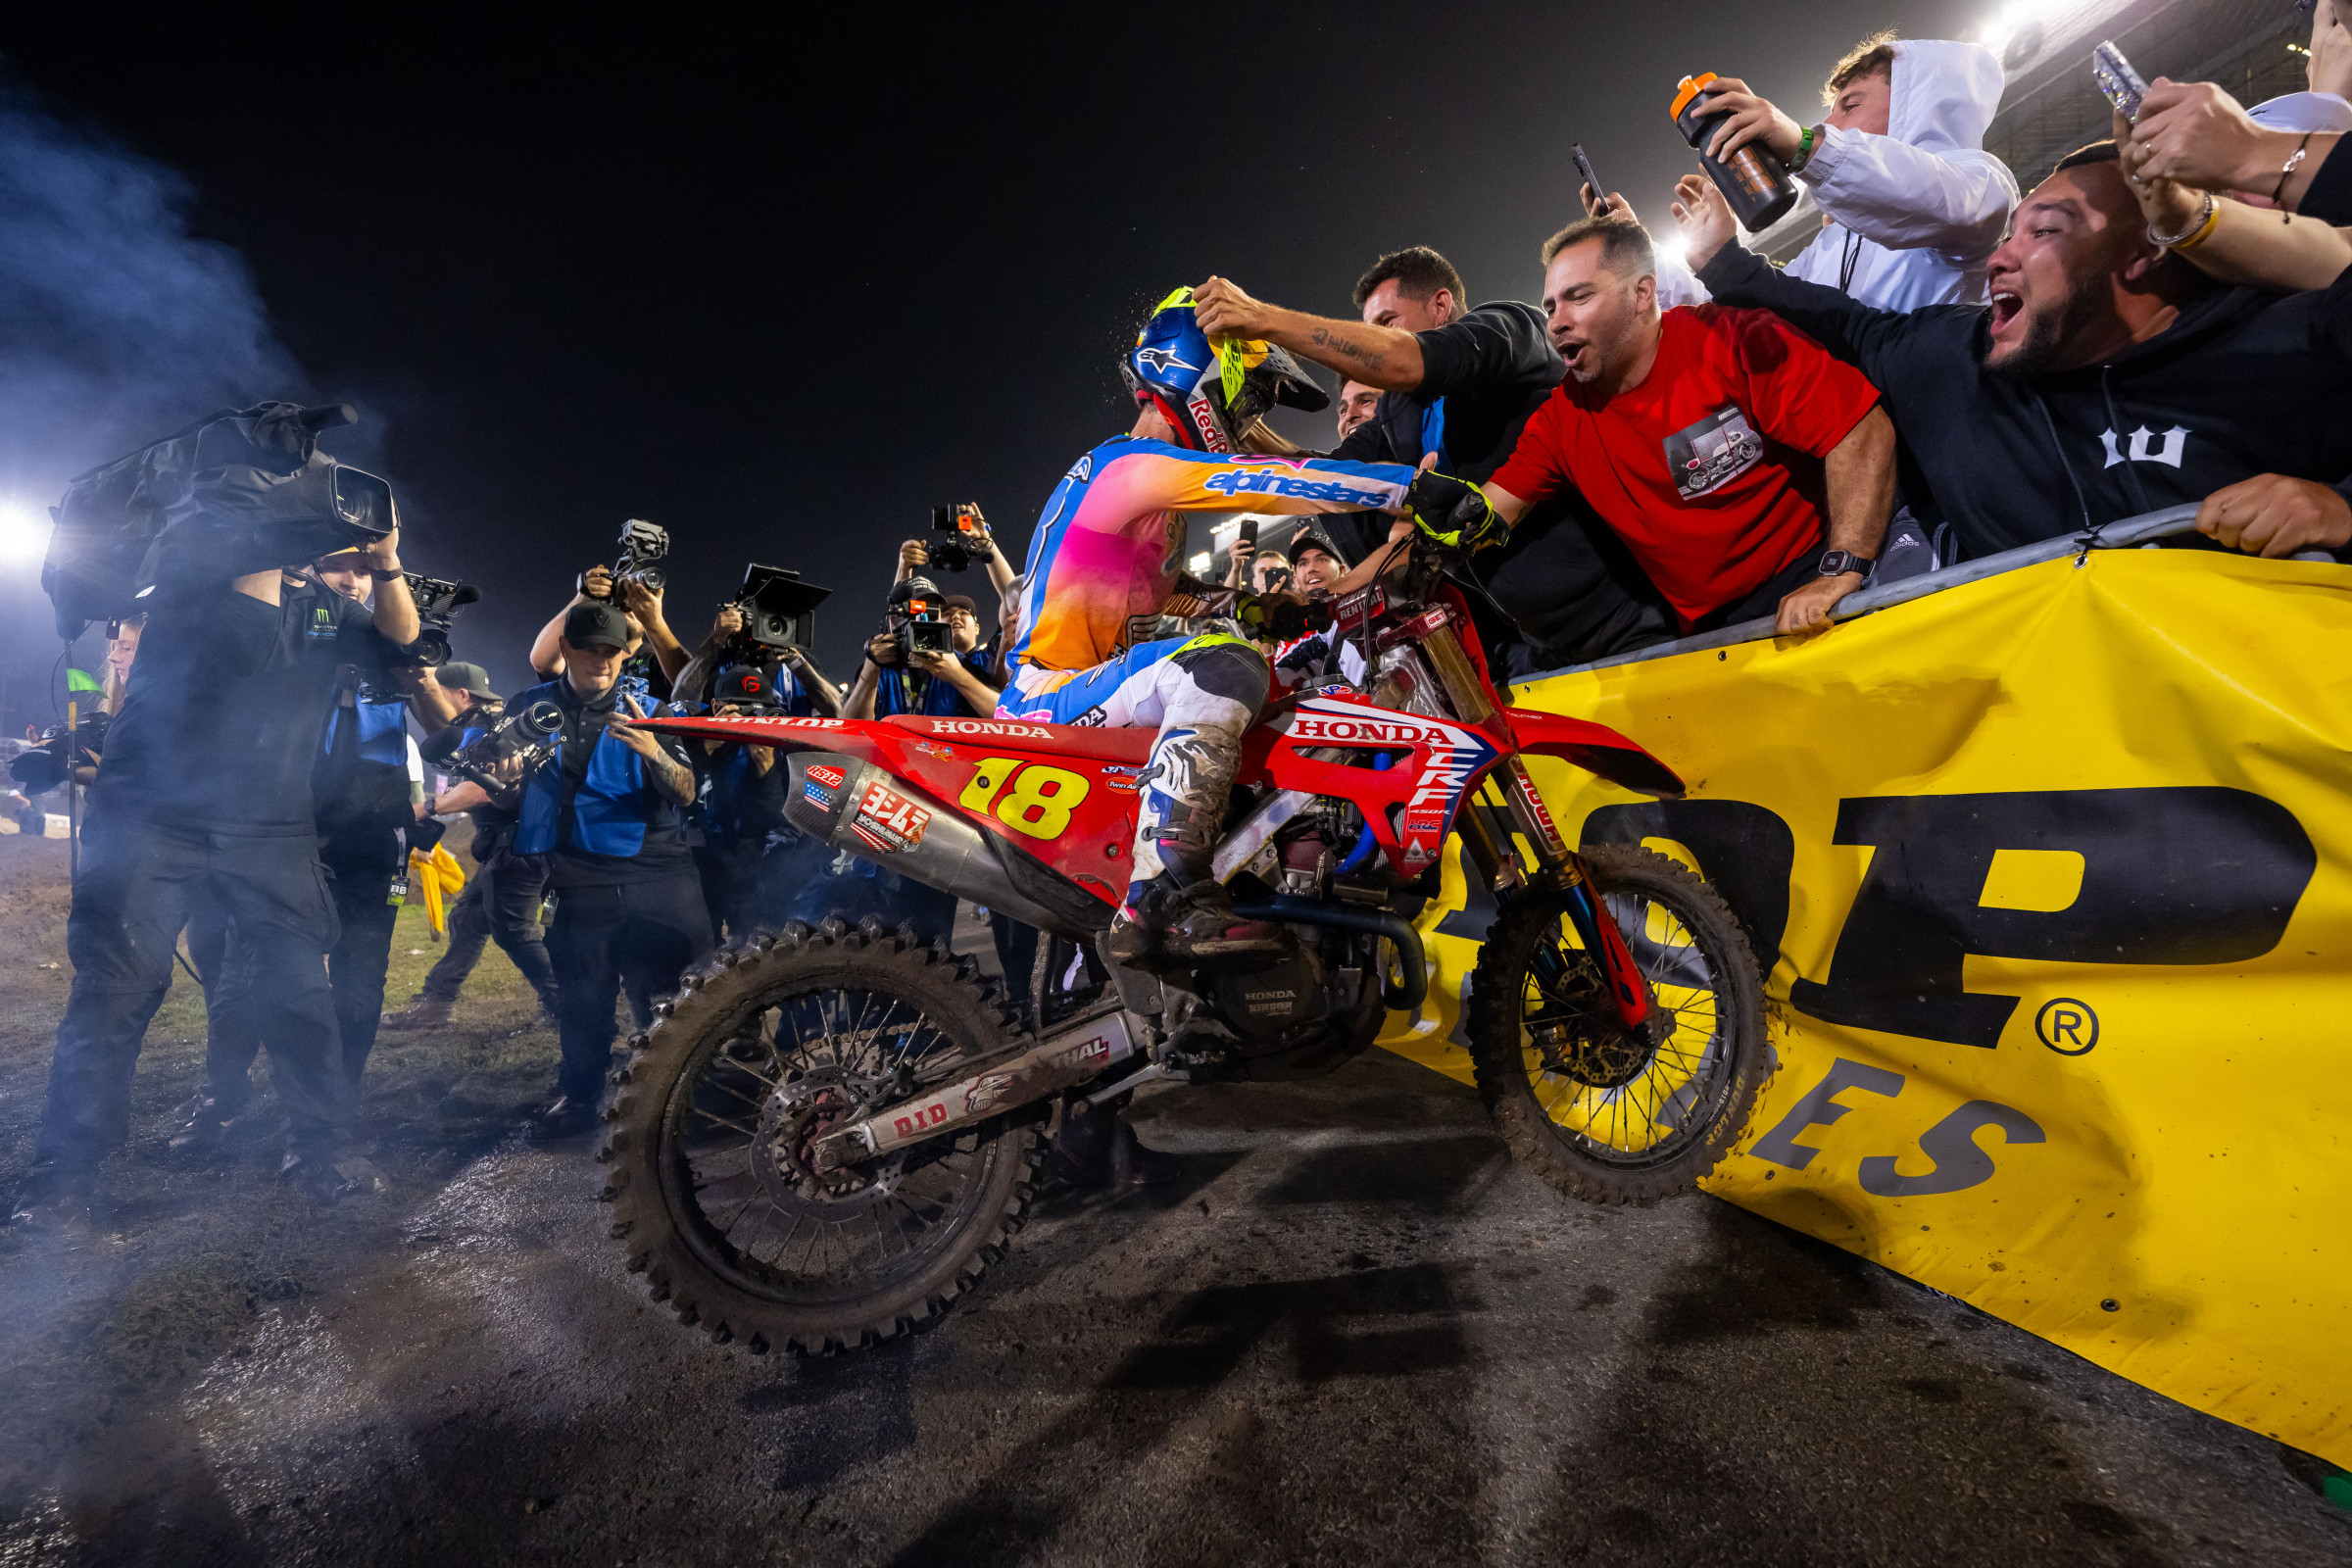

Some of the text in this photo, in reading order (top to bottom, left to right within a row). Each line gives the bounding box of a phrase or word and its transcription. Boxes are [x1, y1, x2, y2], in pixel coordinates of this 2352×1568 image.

[1205, 468, 1392, 508] alpinestars
[1890, 540, 1920, 552] adidas
[931, 720, 1054, 739] HONDA
[1294, 719, 1455, 746] HONDA
[860, 785, 930, 836] ヨシムラ
[958, 757, 1091, 841] 18
[1409, 819, 1441, 830] HRC
[1244, 990, 1297, 1001] HONDA
